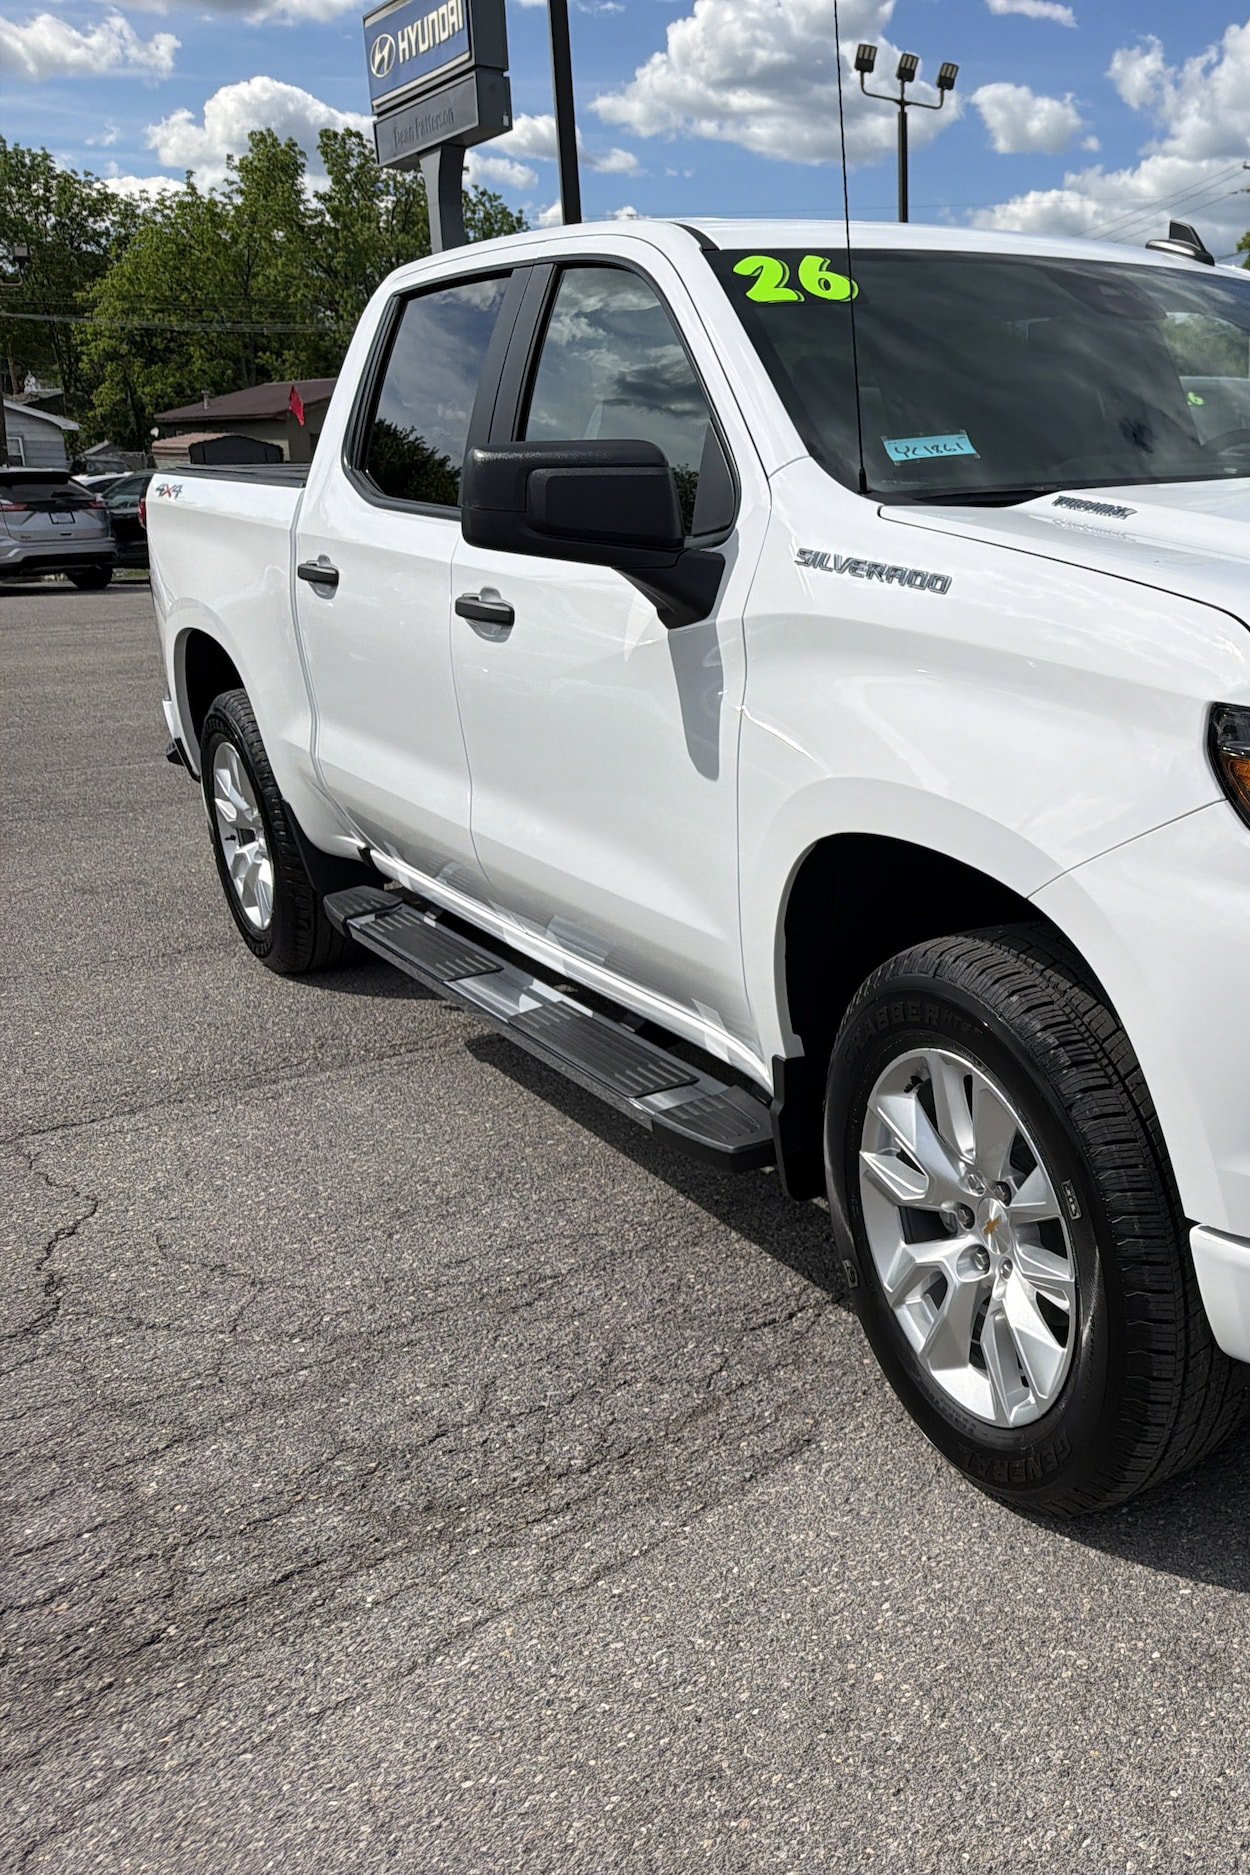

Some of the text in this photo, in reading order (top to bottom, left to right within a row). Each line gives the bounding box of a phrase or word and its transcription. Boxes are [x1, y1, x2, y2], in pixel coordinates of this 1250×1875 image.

[398, 0, 463, 64] HYUNDAI
[732, 254, 859, 303] 26
[794, 547, 953, 596] SILVERADO
